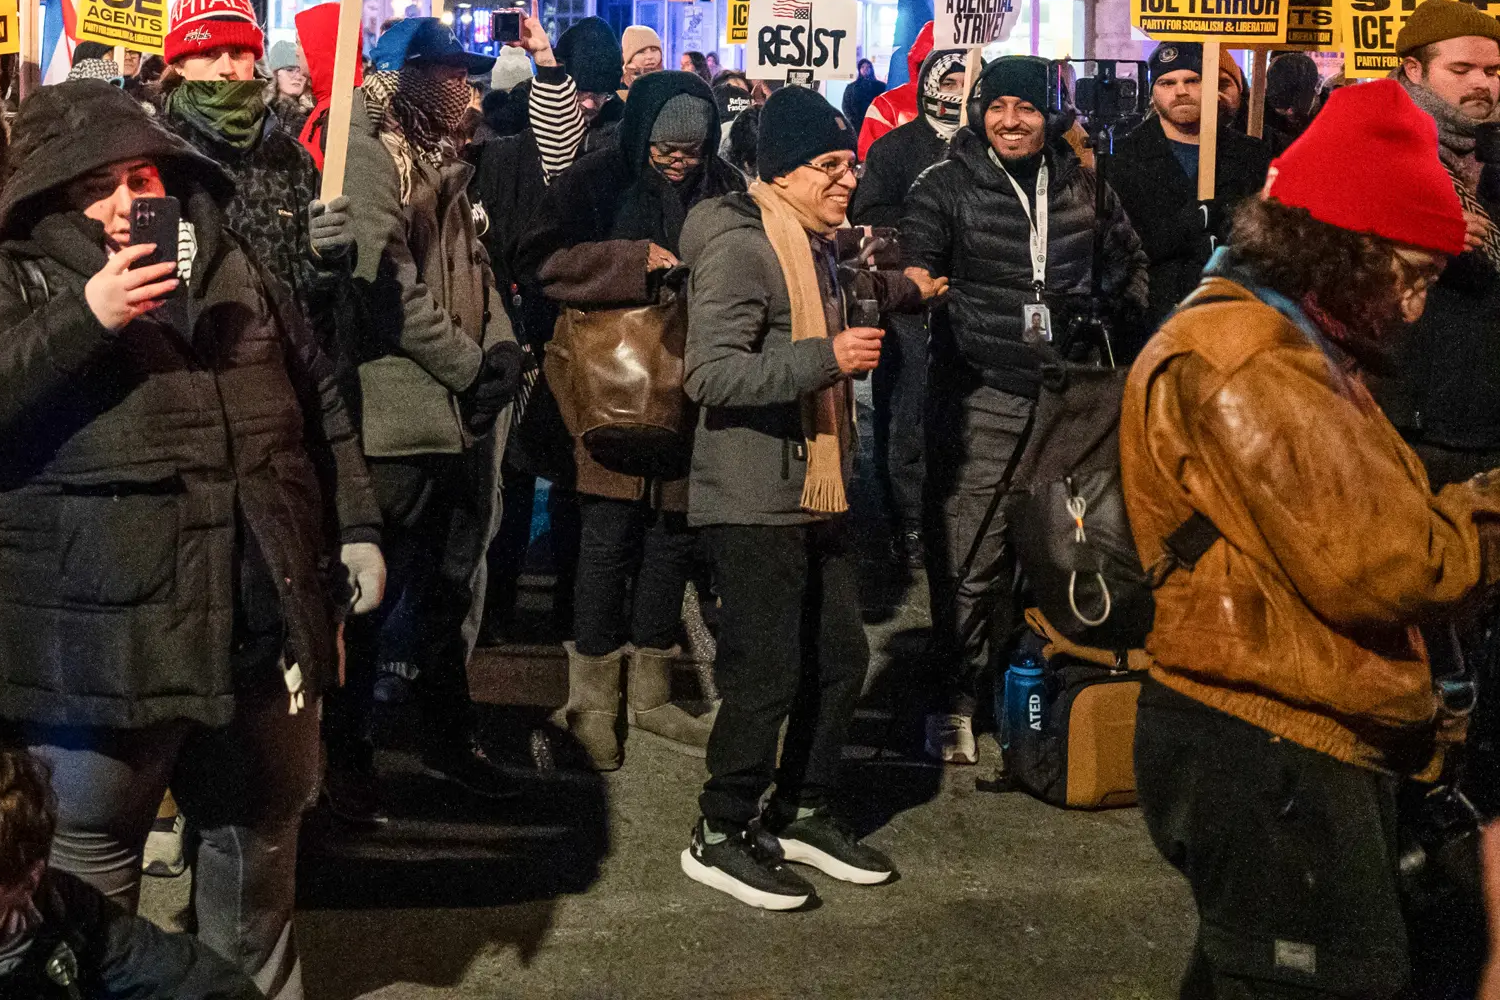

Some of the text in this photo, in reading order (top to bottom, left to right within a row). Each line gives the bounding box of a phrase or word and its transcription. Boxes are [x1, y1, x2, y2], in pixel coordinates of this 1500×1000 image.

[87, 5, 162, 31] AGENTS
[733, 4, 750, 26] IC
[1141, 19, 1276, 33] PARTY FOR SOCIALISM & LIBERATION
[1352, 15, 1395, 50] ICE
[758, 24, 847, 69] RESIST
[1357, 57, 1381, 67] PARTY
[1382, 57, 1398, 68] FOR
[1029, 694, 1041, 731] ATED
